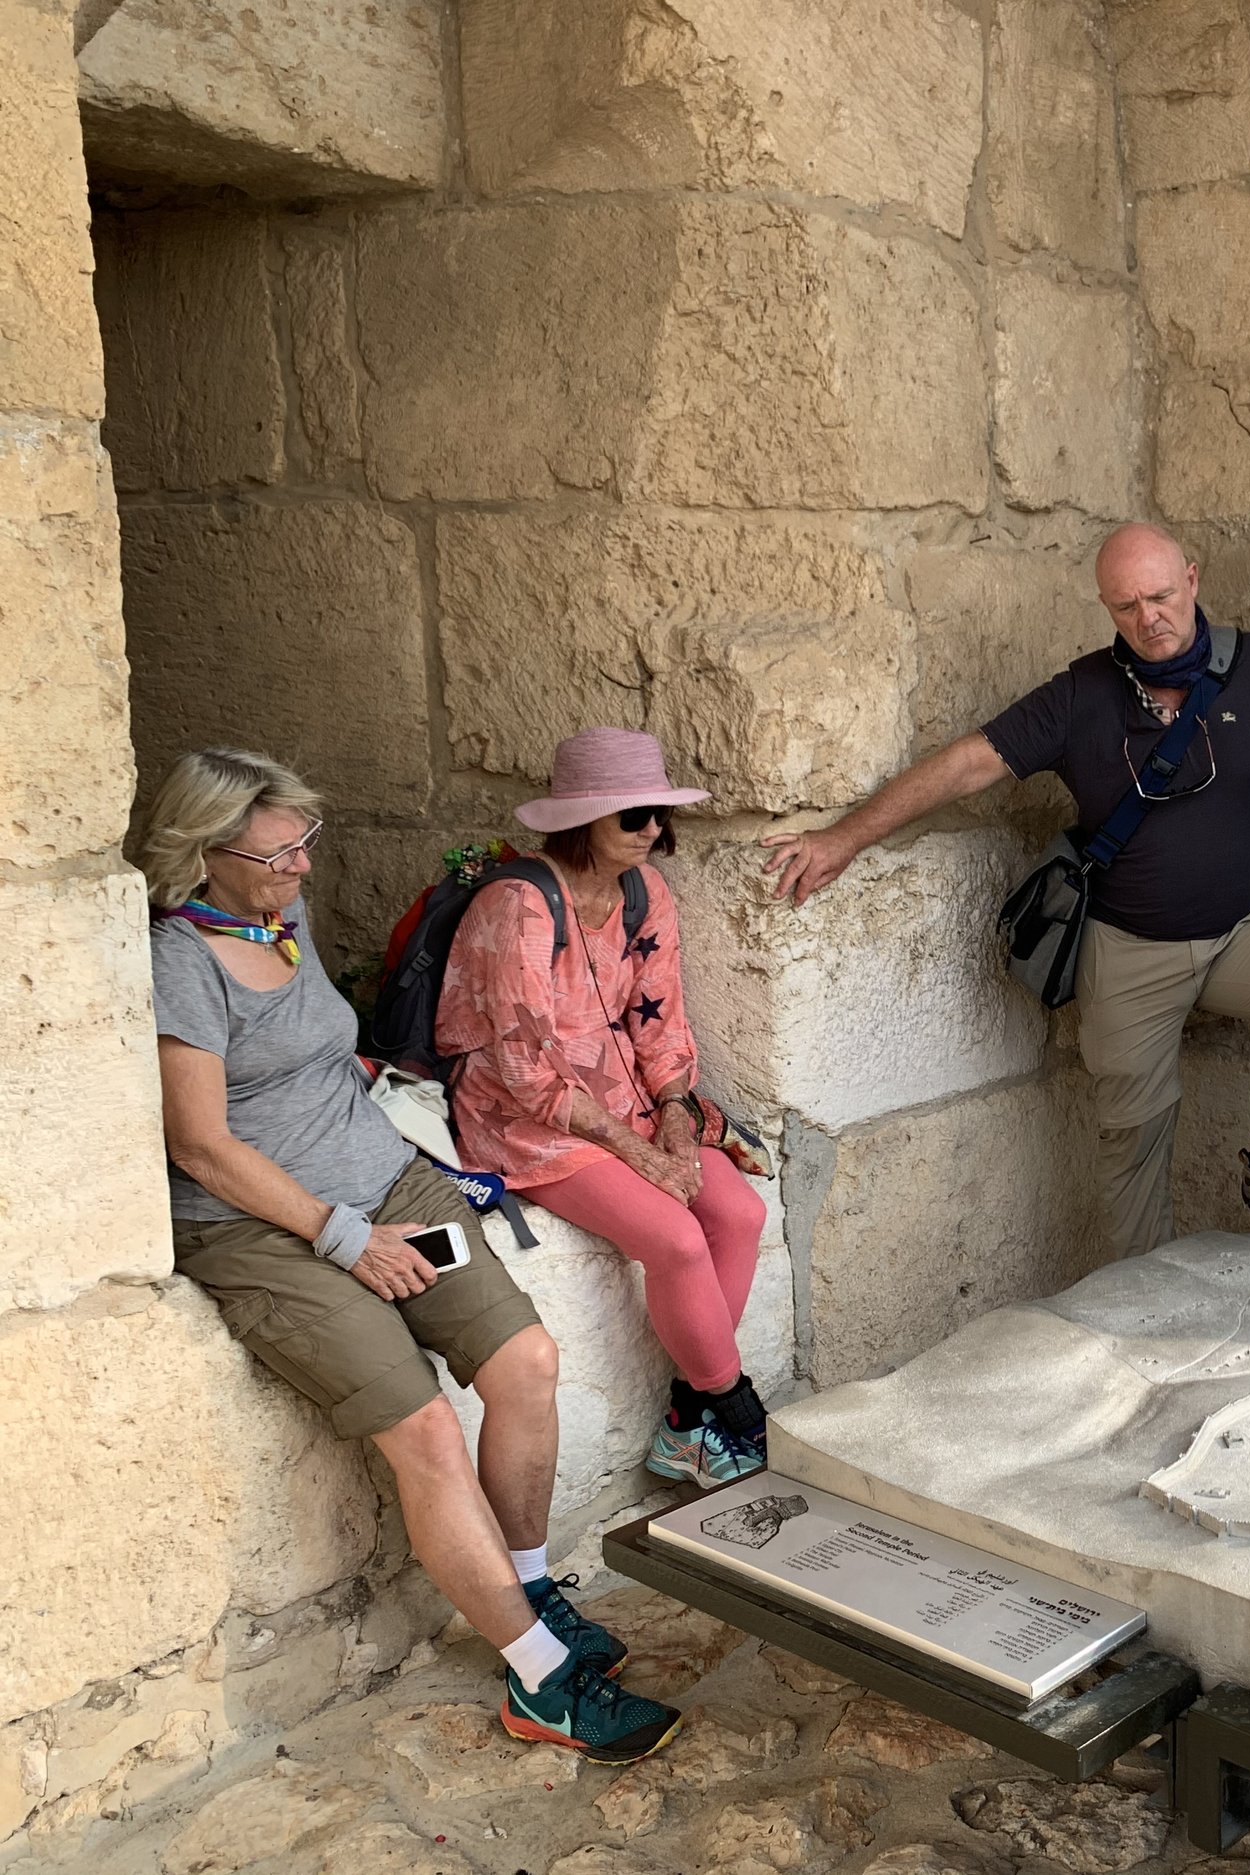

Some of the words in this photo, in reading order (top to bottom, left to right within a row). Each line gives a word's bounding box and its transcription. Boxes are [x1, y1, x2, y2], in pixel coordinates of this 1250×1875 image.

[446, 1176, 493, 1206] Copp
[854, 1522, 892, 1538] Jerusalem
[845, 1527, 876, 1540] Second
[874, 1538, 902, 1551] Temple
[902, 1549, 930, 1561] Period
[1058, 1599, 1101, 1616] ירושלים
[1068, 1612, 1091, 1624] בימי
